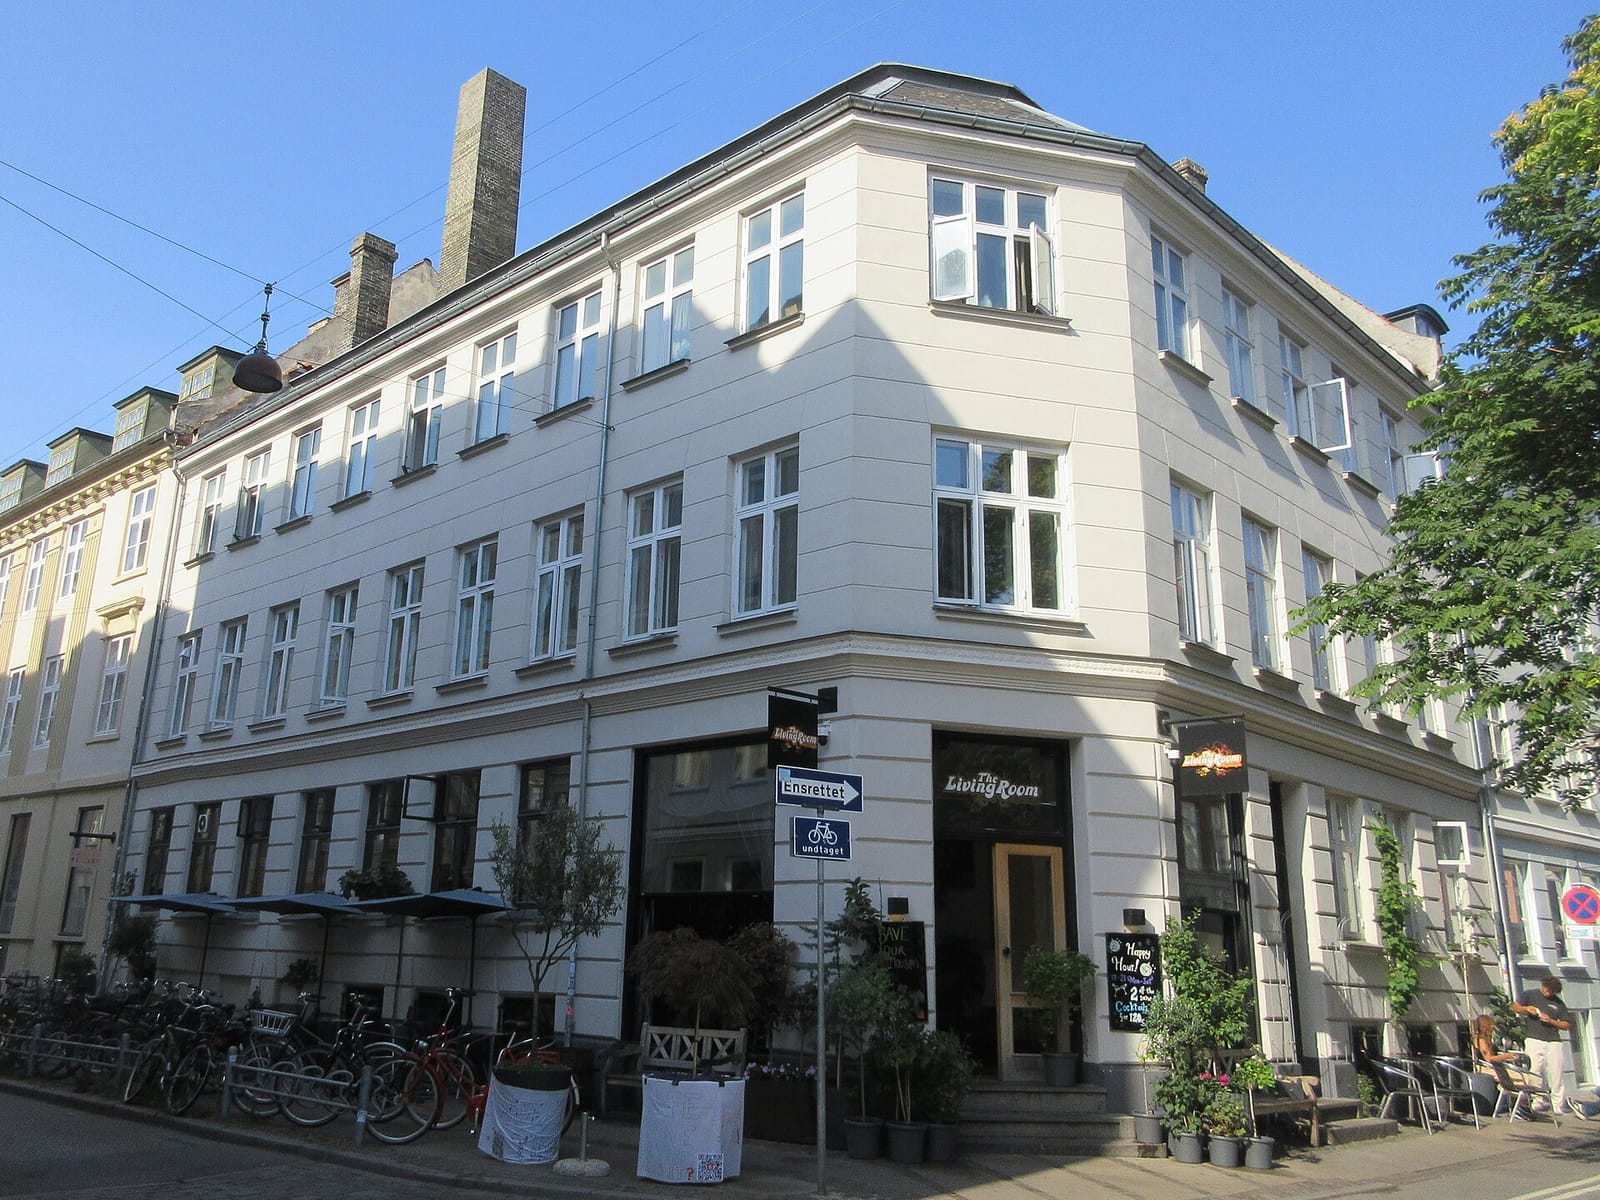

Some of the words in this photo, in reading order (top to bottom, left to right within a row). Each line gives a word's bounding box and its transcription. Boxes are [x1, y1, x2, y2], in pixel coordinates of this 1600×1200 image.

[978, 772, 998, 784] The
[784, 780, 845, 799] Ensrettet
[802, 844, 844, 856] undtaget
[1126, 942, 1151, 960] Happy
[1111, 956, 1140, 973] Hour!
[1130, 985, 1138, 1002] 2
